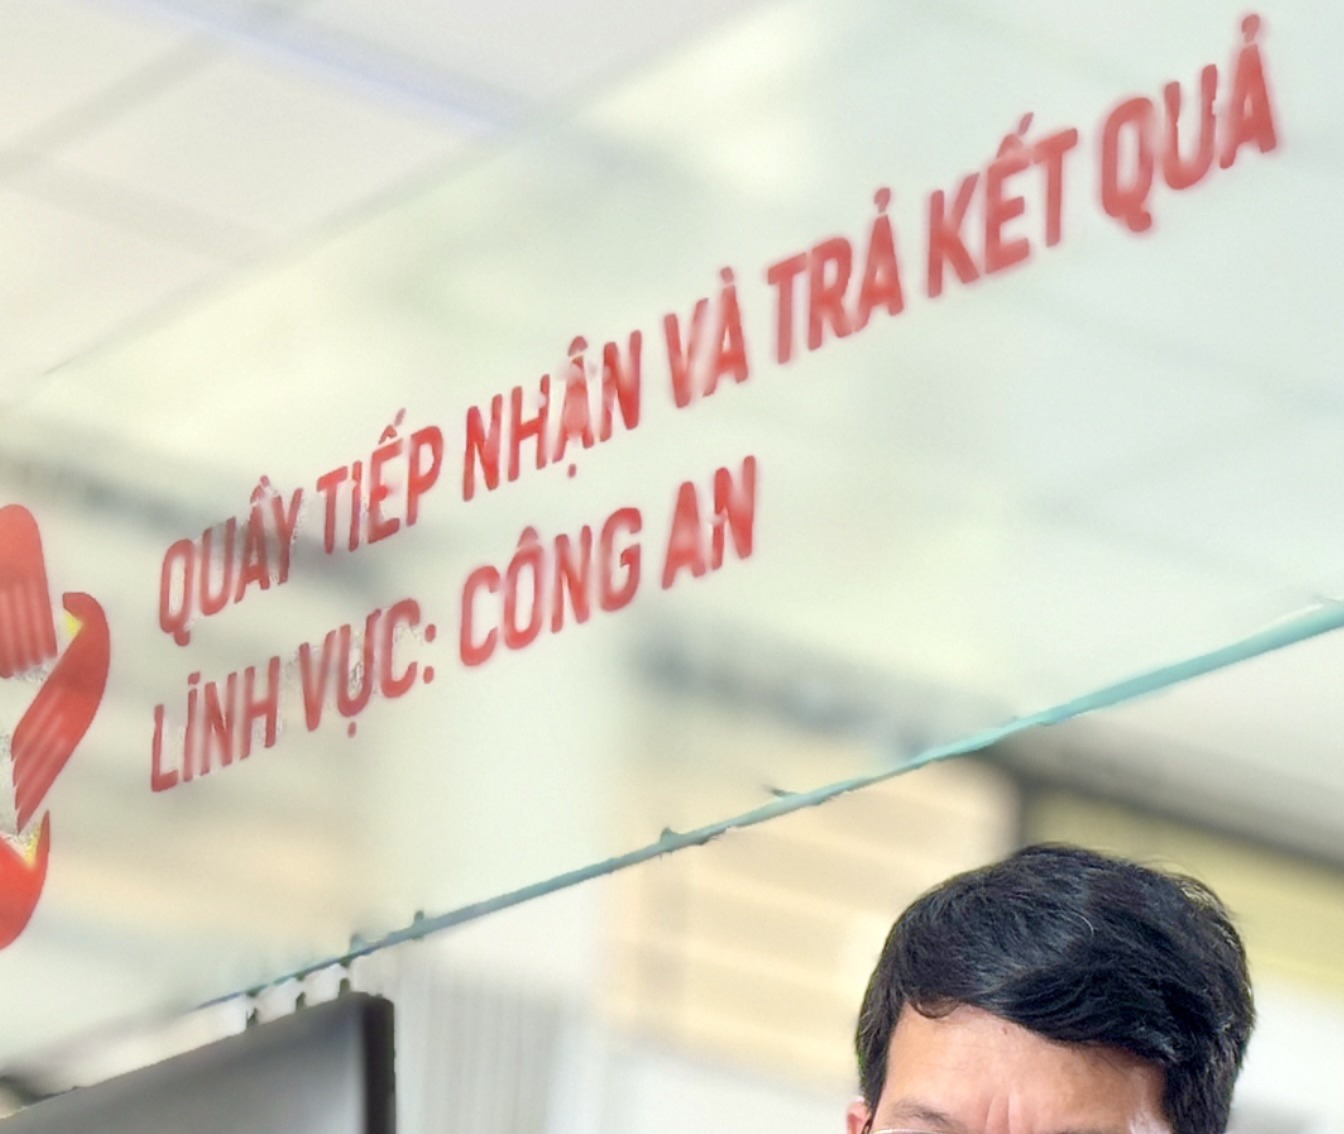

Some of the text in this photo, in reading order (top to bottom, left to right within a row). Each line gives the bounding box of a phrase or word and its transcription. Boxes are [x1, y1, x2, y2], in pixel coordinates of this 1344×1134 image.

[316, 408, 444, 555] TIẾP
[463, 330, 642, 501] NHẬN
[664, 266, 749, 409] VÀ
[767, 187, 904, 365] TRẢ
[927, 112, 1079, 299] KẾT
[1101, 14, 1278, 233] QUẢ
[151, 454, 756, 792] LĨNH VỰC: CÔNG AN
